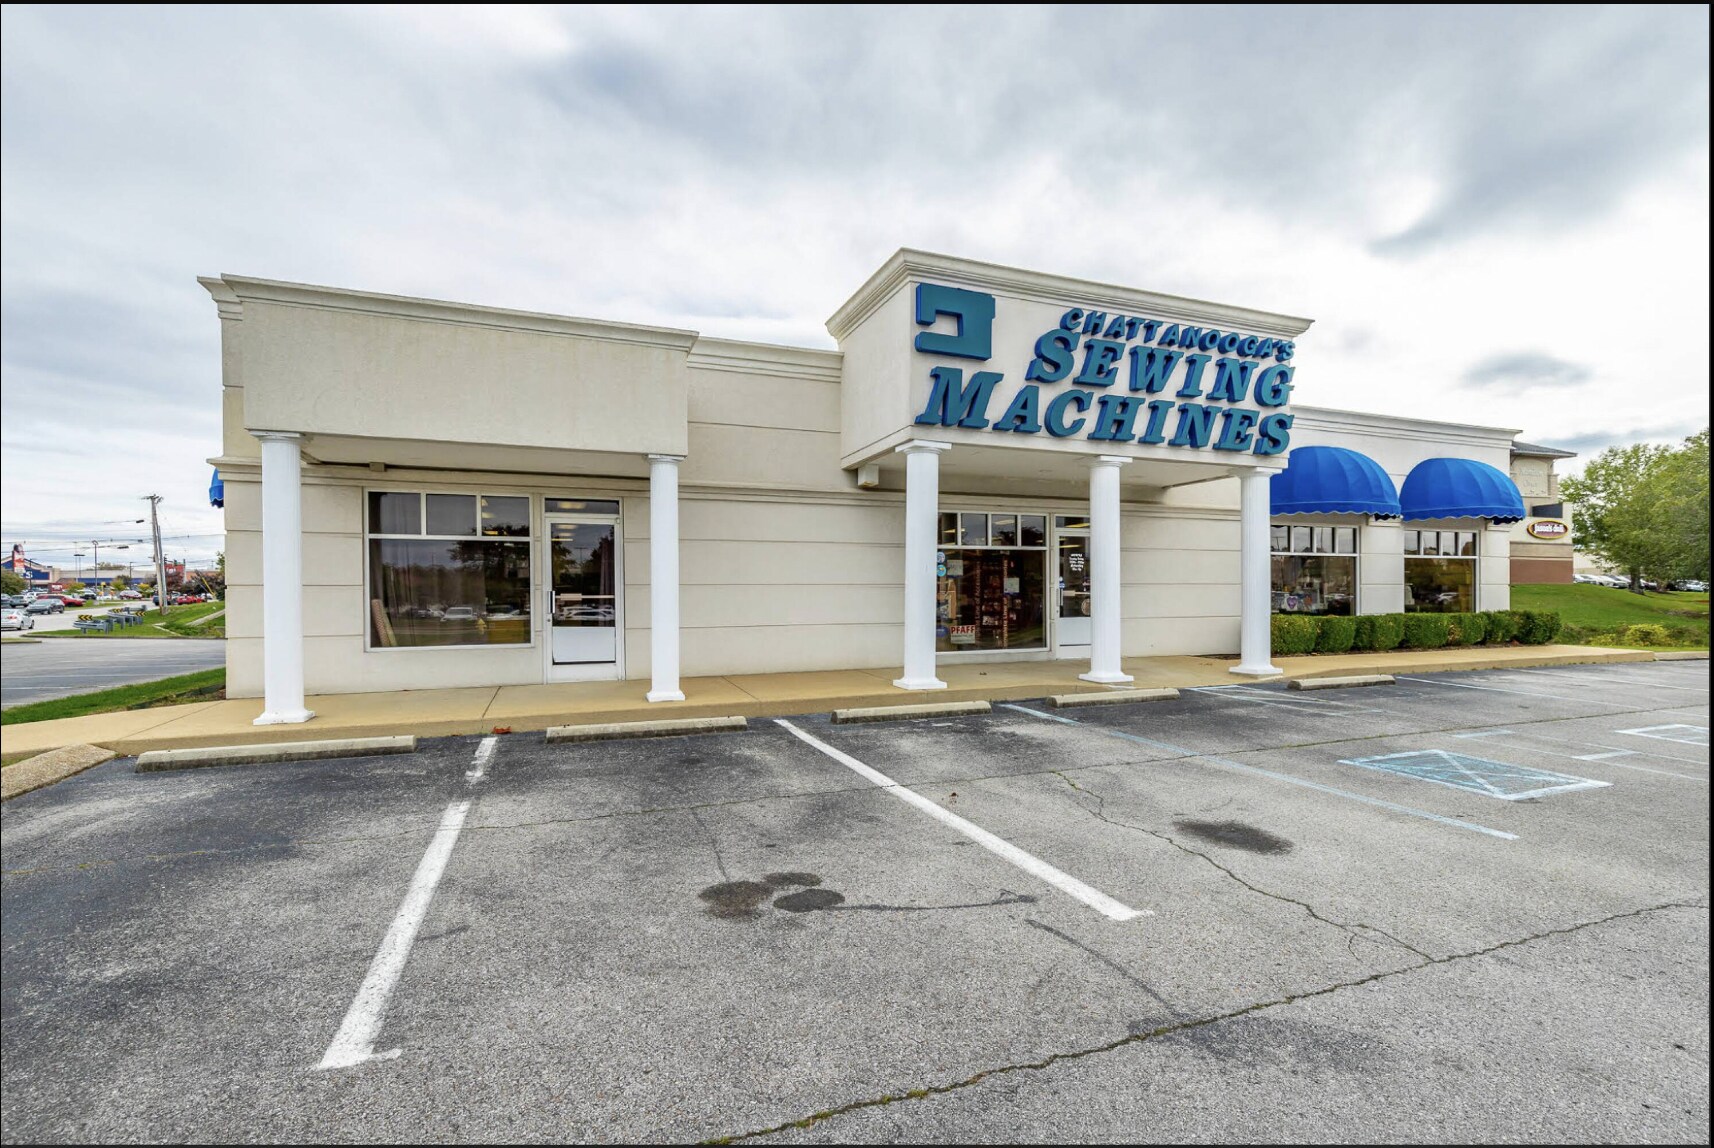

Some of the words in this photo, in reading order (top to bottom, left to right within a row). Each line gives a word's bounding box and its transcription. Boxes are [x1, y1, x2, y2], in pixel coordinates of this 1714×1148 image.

[1025, 328, 1295, 407] SEWING
[1059, 307, 1295, 362] CHATTANOOGA'S
[915, 366, 1295, 456] MACHINES
[951, 625, 974, 634] PFAFF
